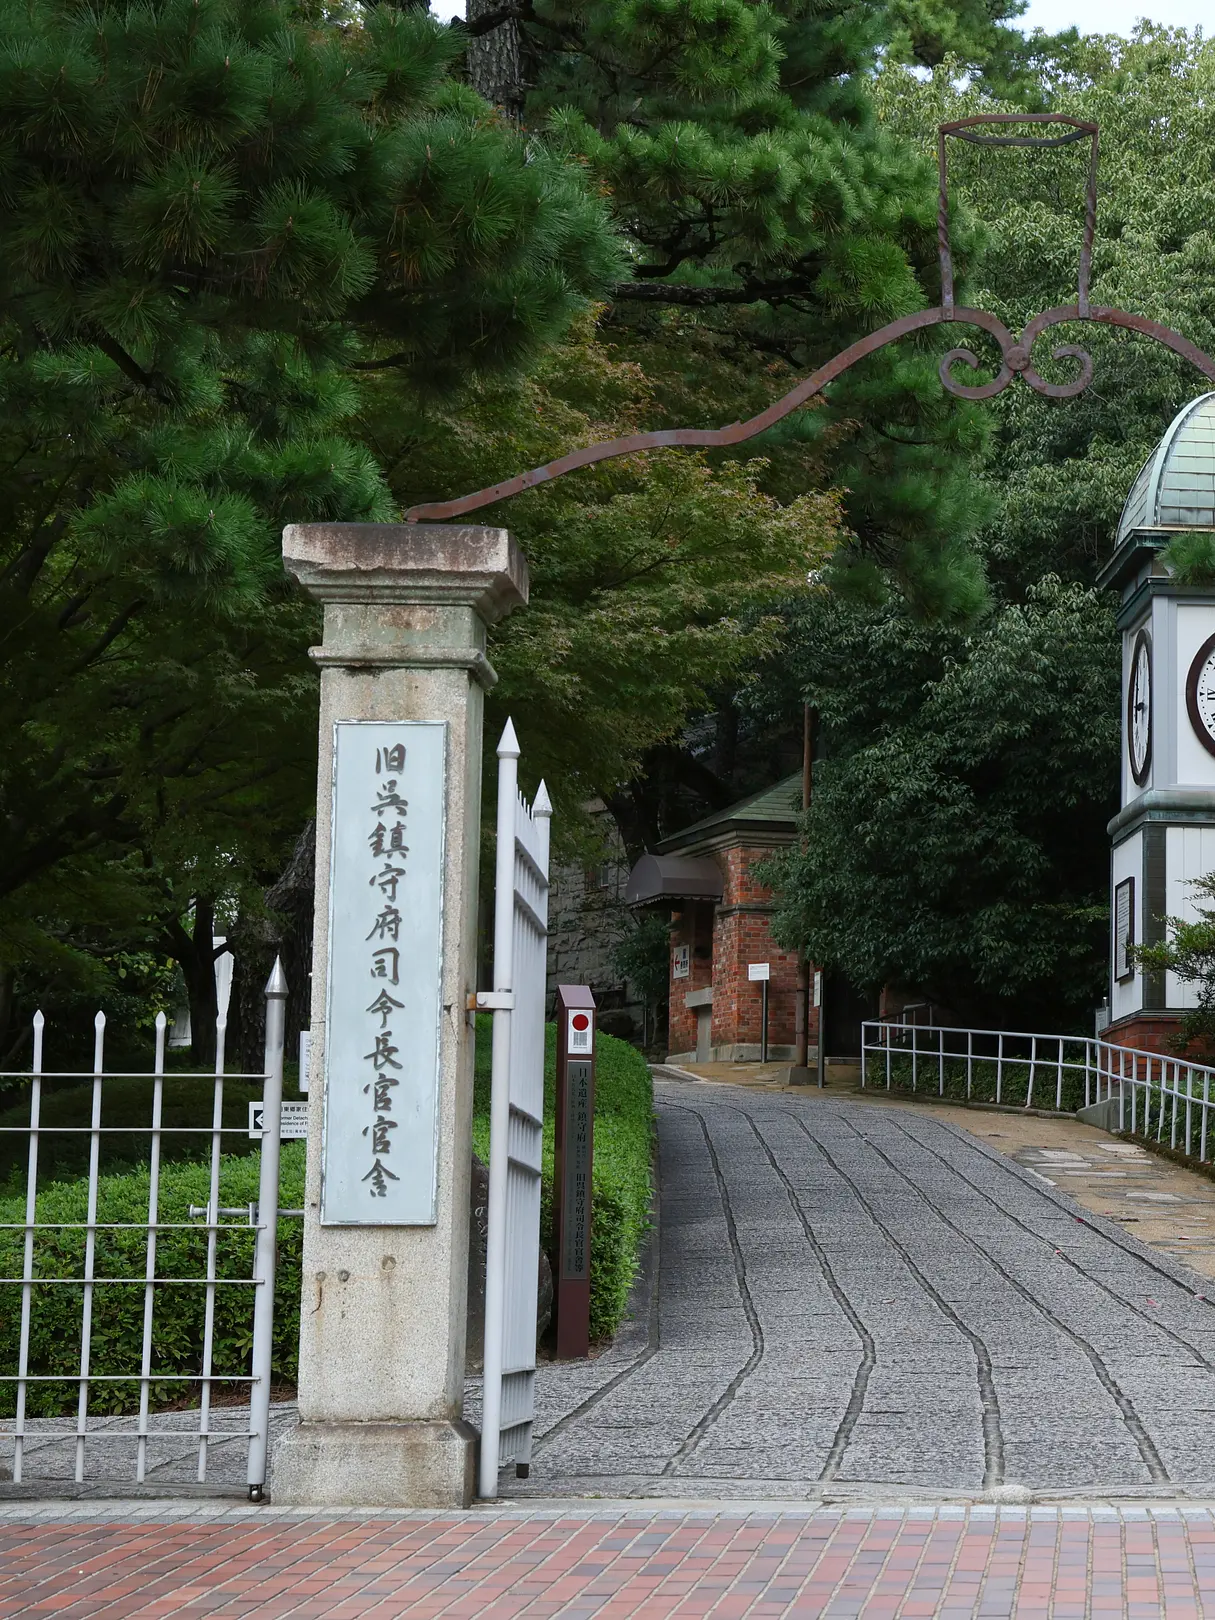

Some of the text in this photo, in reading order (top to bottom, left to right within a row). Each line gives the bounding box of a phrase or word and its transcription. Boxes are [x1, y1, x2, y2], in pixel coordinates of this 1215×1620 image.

[361, 743, 409, 1198] 旧呉鎮守府司令長官官舎
